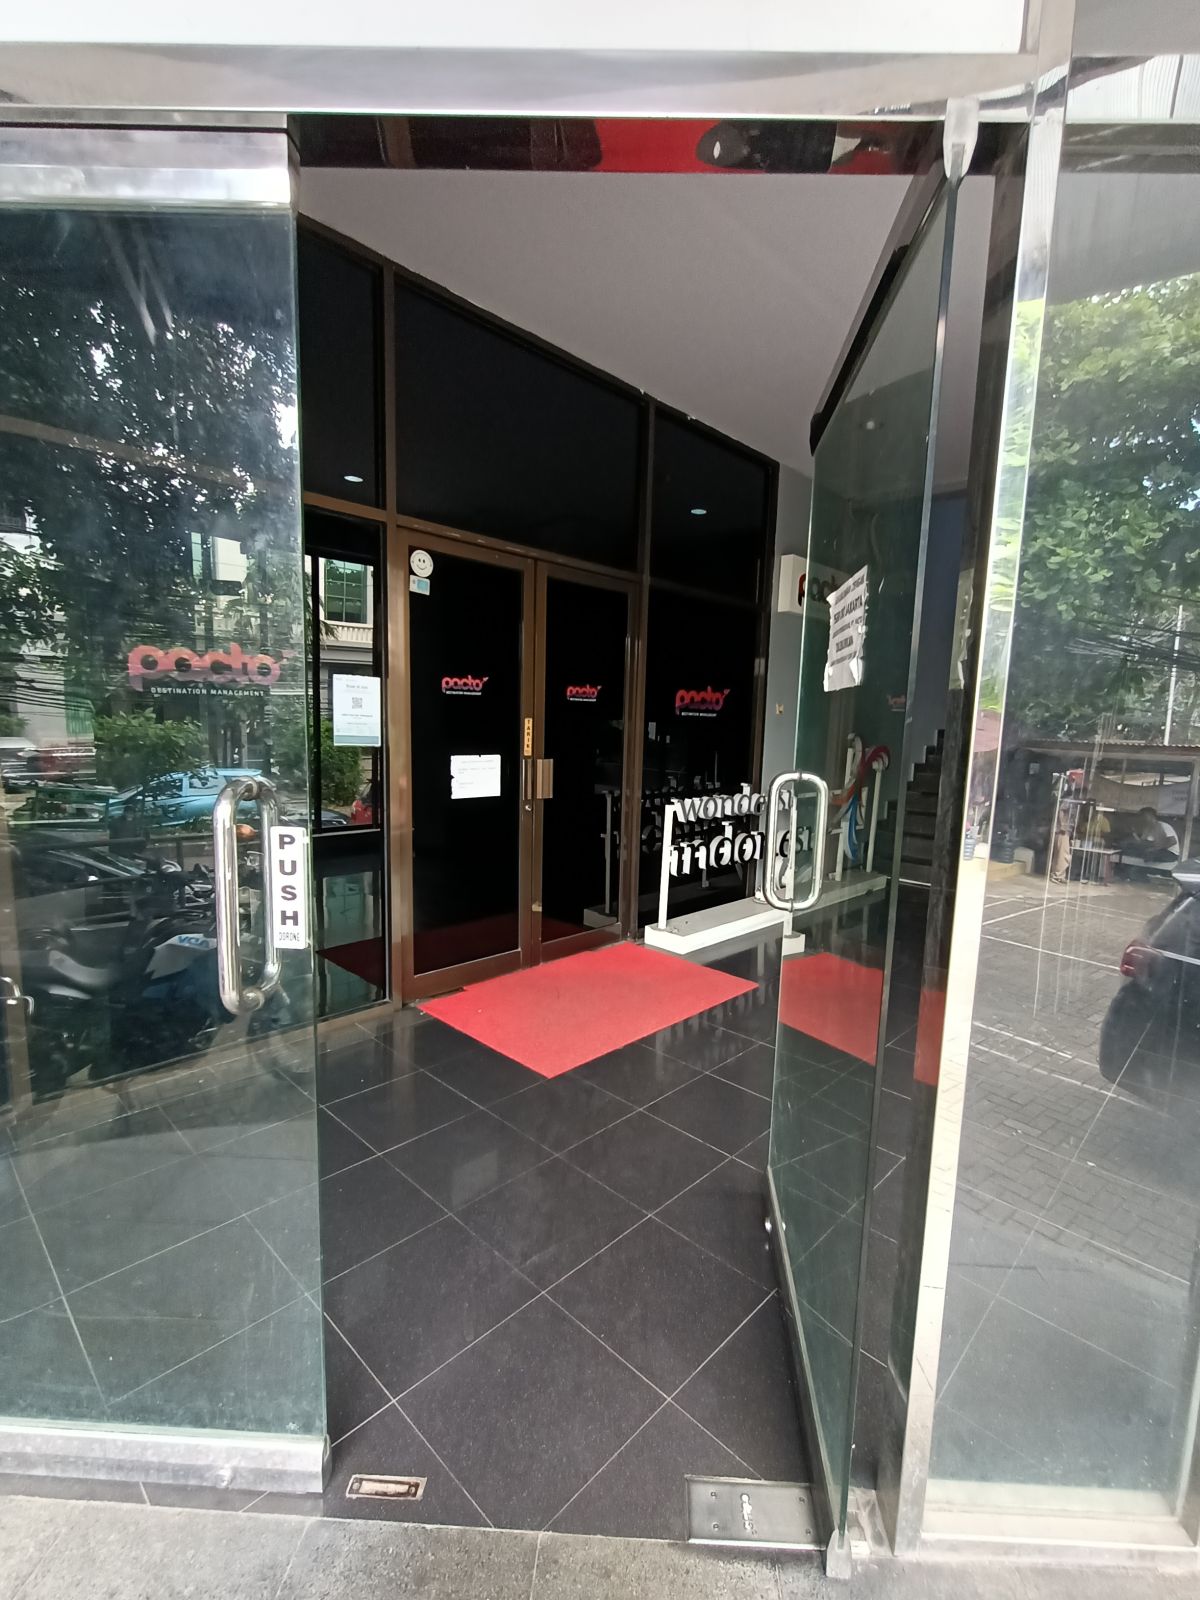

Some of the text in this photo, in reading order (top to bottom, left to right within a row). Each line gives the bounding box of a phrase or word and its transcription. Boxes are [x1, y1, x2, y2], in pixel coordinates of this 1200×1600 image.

[128, 642, 282, 692] pacto
[151, 686, 265, 698] DESTINATION MANAGEMENT
[278, 833, 299, 926] PUSH
